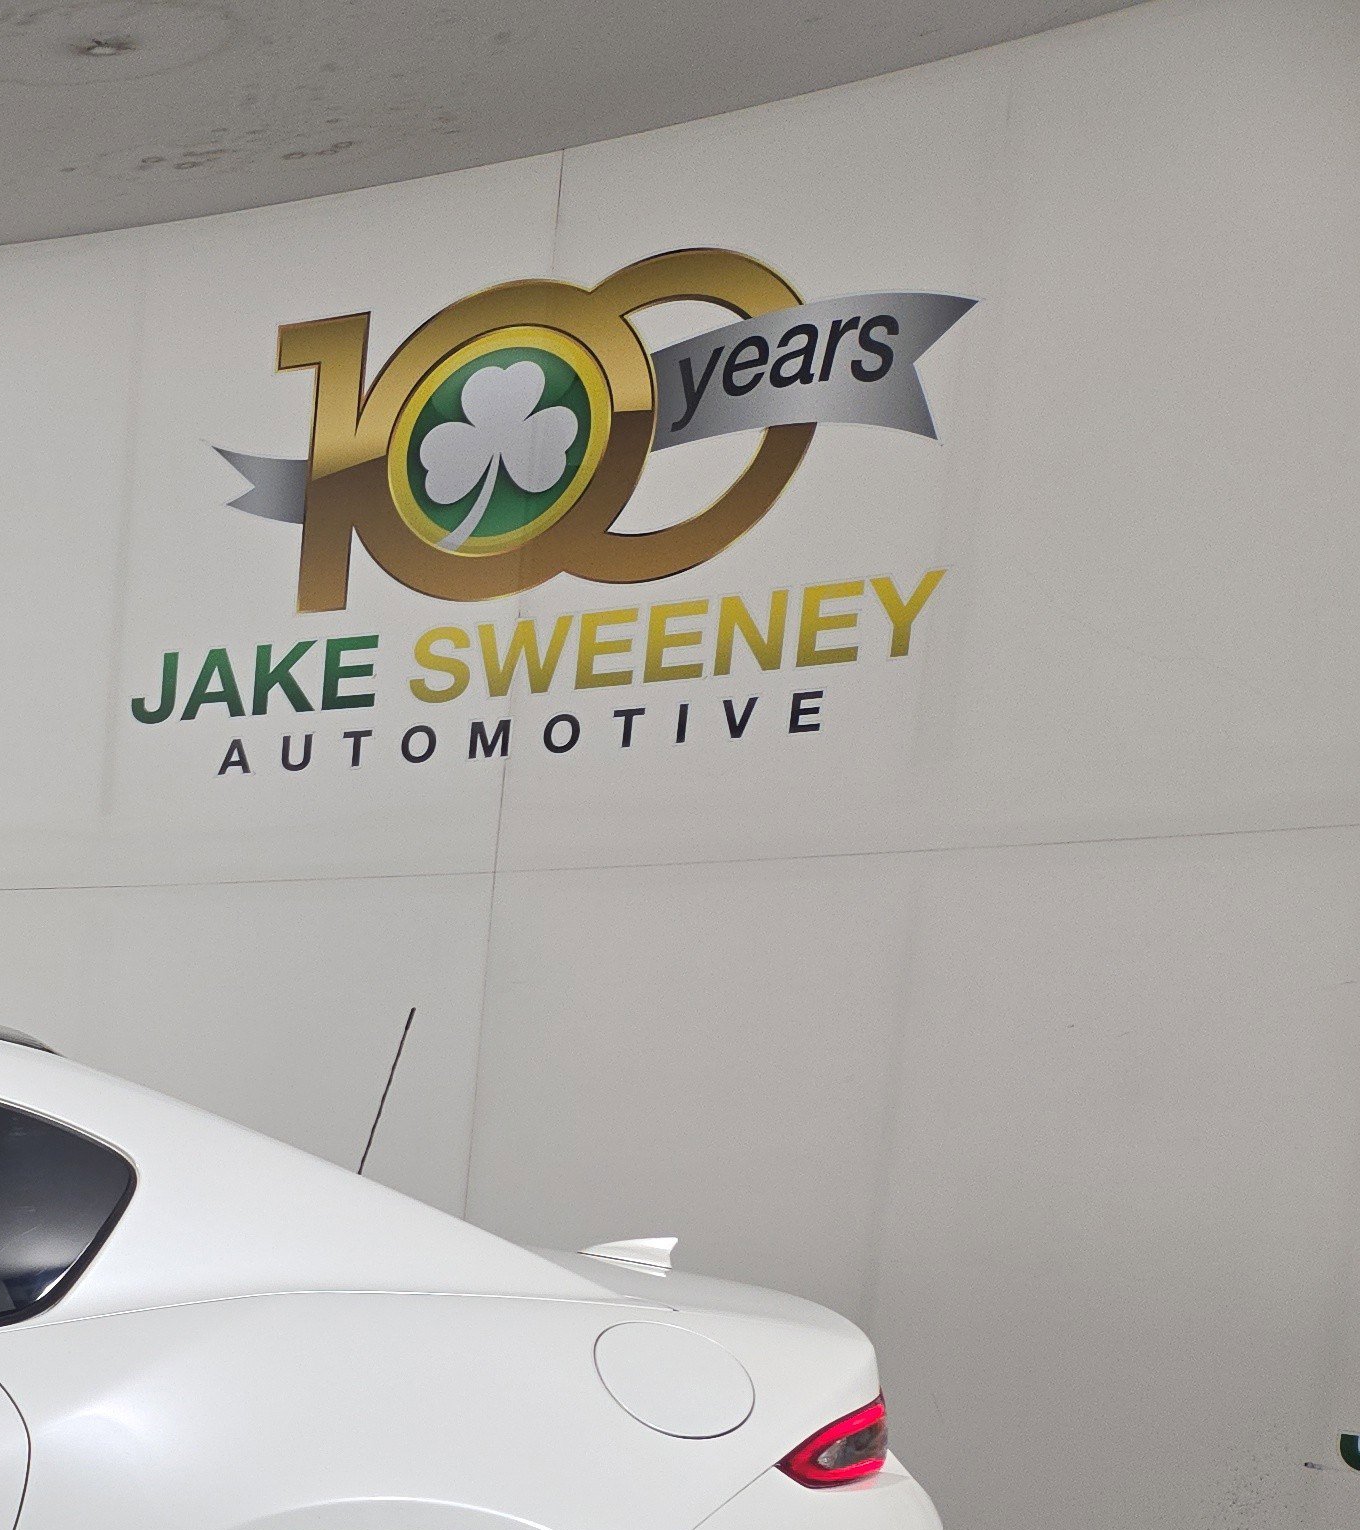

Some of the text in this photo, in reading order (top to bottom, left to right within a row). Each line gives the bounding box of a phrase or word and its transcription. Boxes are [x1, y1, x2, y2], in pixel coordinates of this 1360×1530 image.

[669, 309, 900, 433] years
[129, 568, 949, 727] JAKE SWEENEY
[217, 690, 825, 776] AUTOMOTIVE
